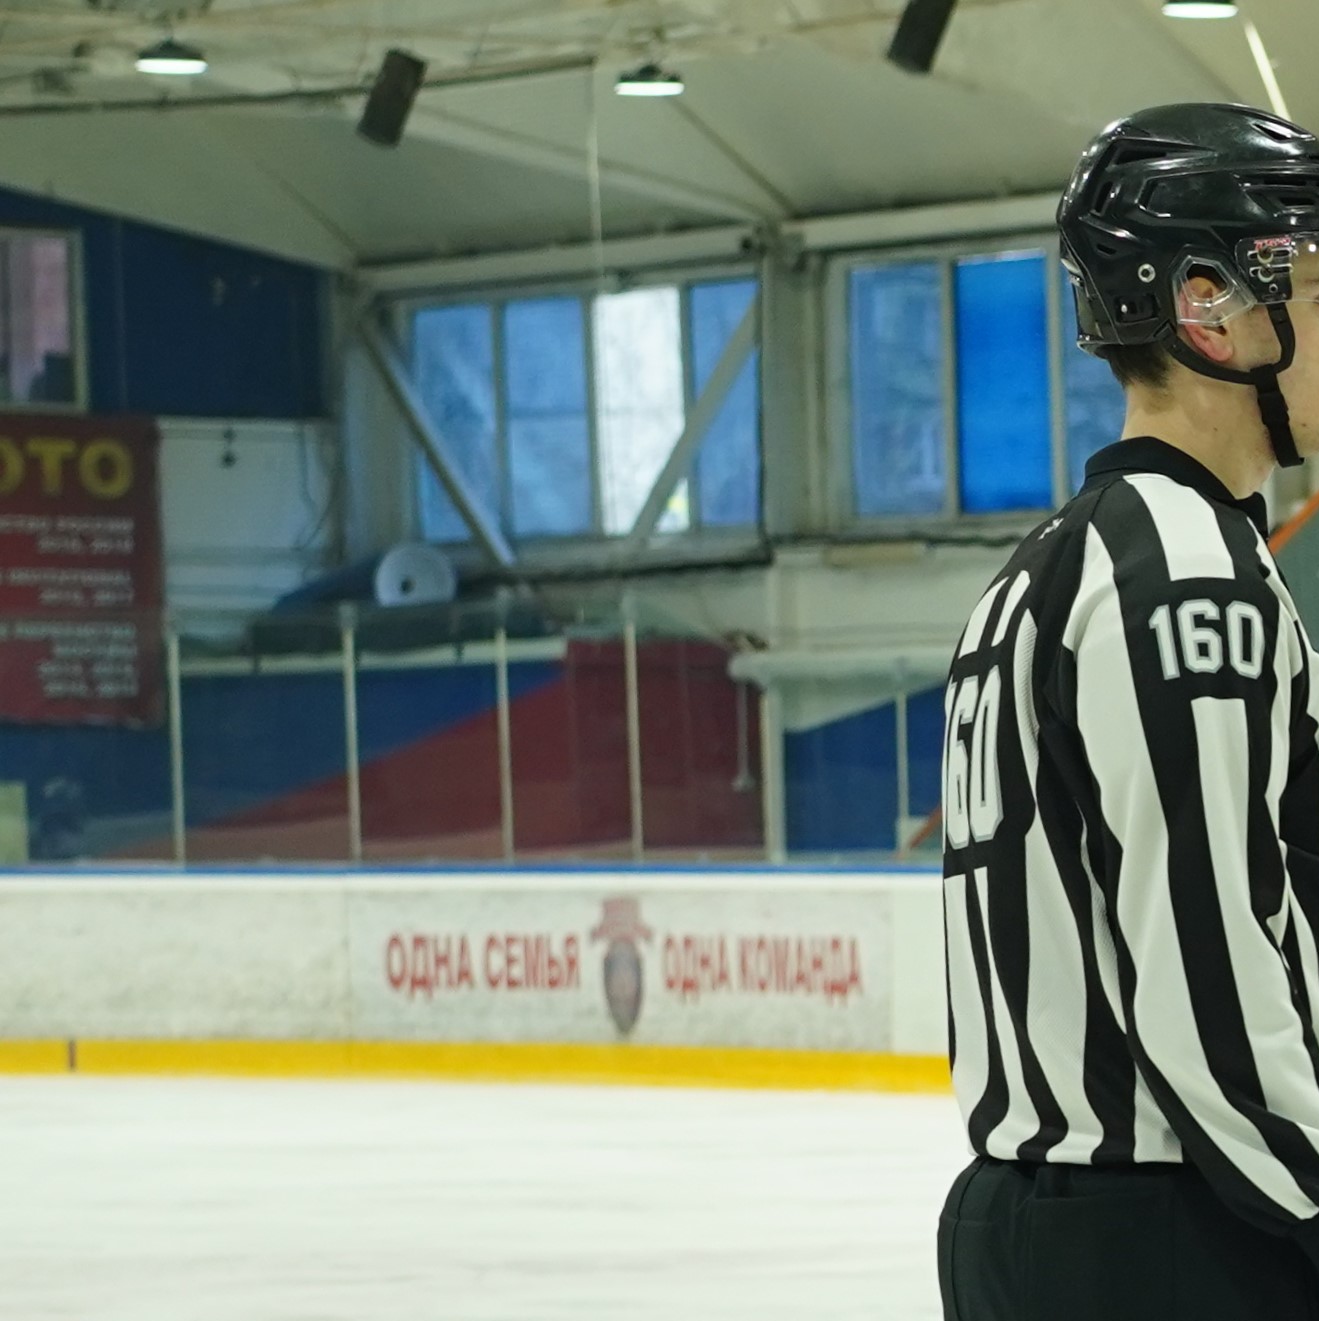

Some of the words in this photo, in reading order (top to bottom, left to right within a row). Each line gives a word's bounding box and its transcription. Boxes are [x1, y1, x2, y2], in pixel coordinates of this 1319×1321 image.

[1148, 598, 1266, 681] 160
[386, 933, 474, 1001] ОДНА
[485, 933, 580, 991] СЕМЬЯ
[664, 934, 732, 1002] ОДНА
[740, 934, 863, 1006] КОМАНДА
